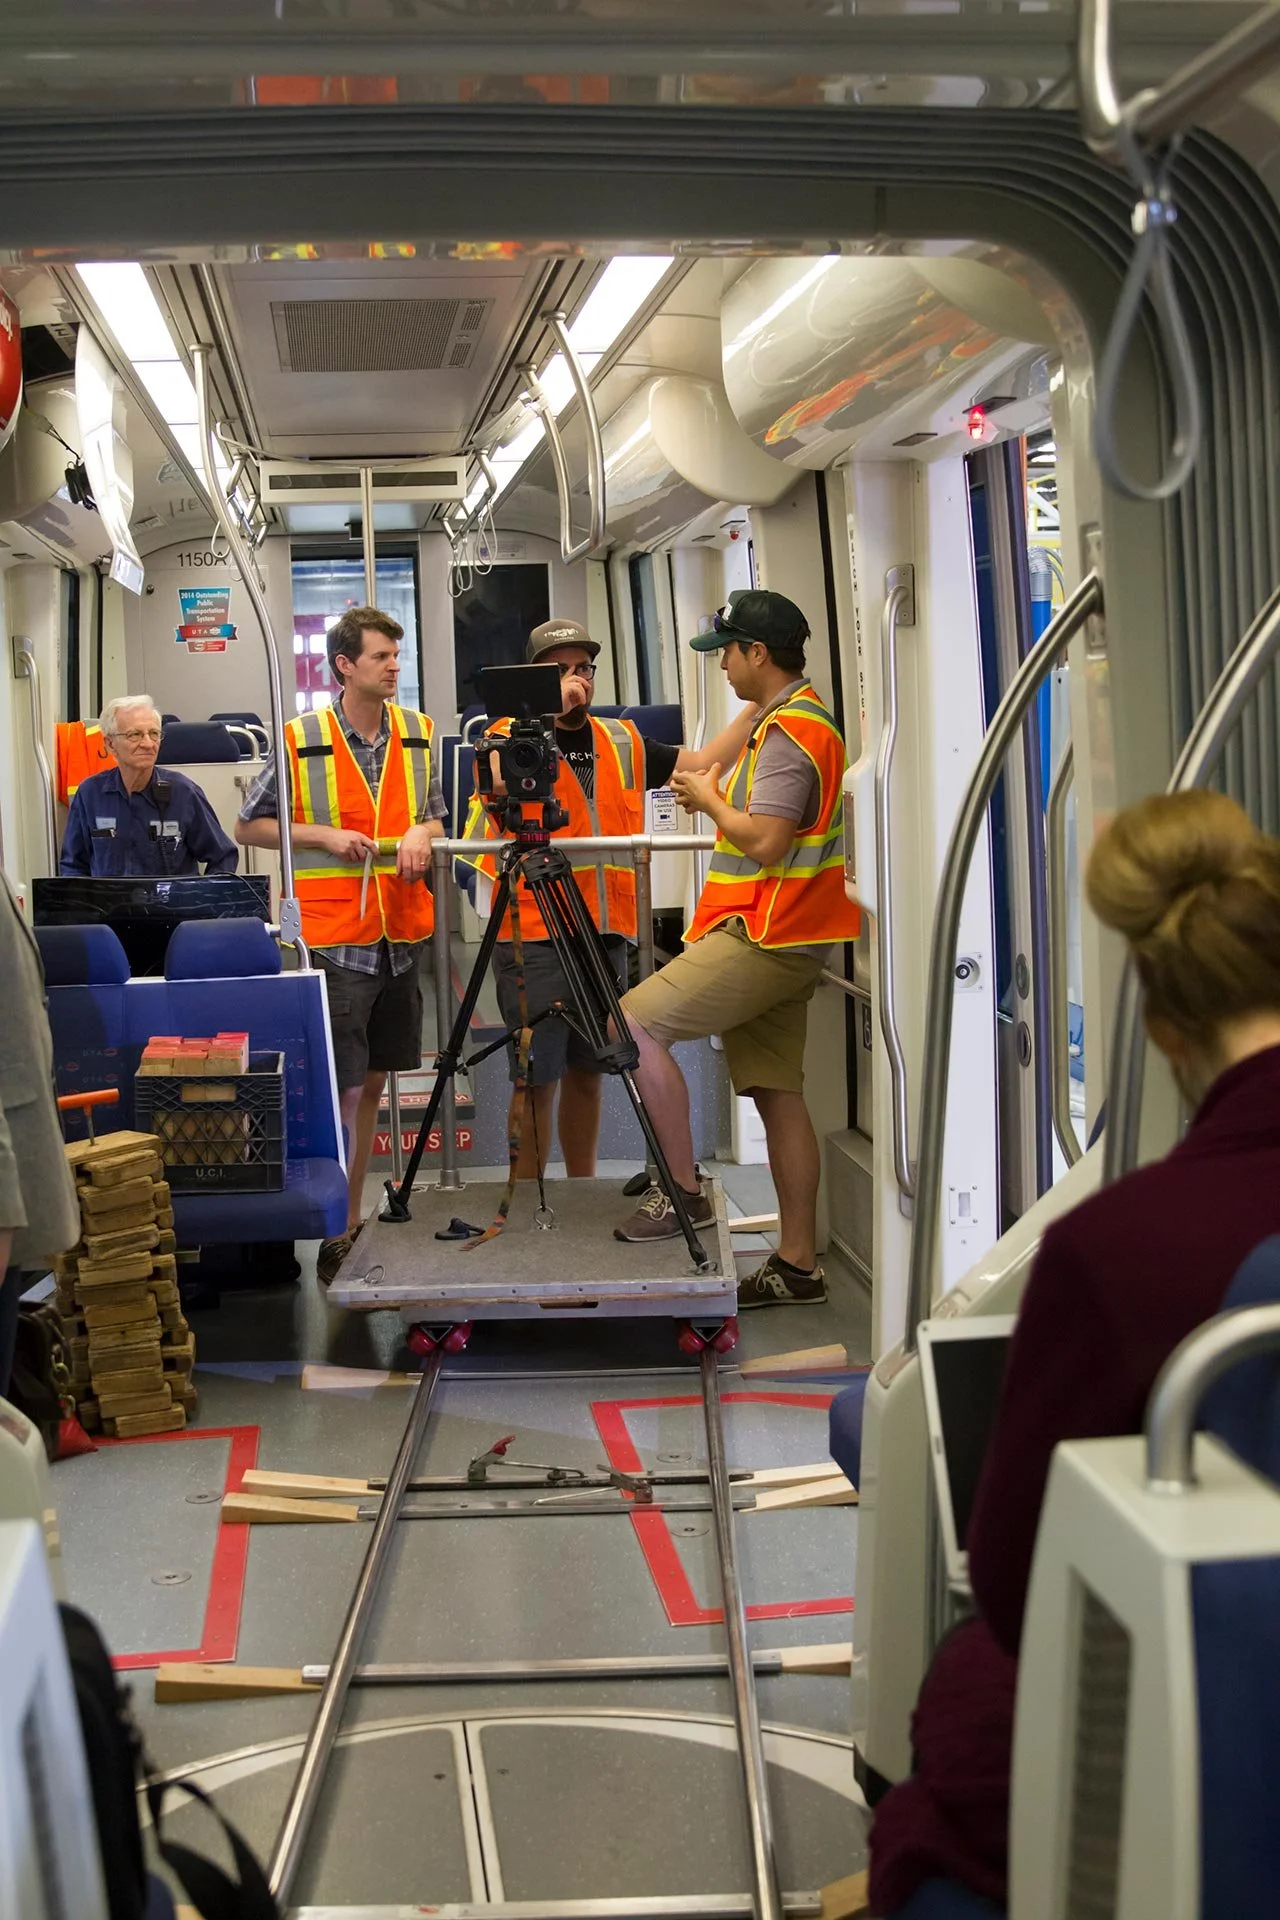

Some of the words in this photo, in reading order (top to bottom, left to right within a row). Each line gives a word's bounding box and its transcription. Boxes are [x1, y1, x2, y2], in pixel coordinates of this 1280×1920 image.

[177, 551, 227, 567] 1150A
[195, 591, 229, 599] Outstanding
[196, 615, 216, 623] System
[378, 1133, 419, 1151] YU
[429, 1132, 471, 1149] SP
